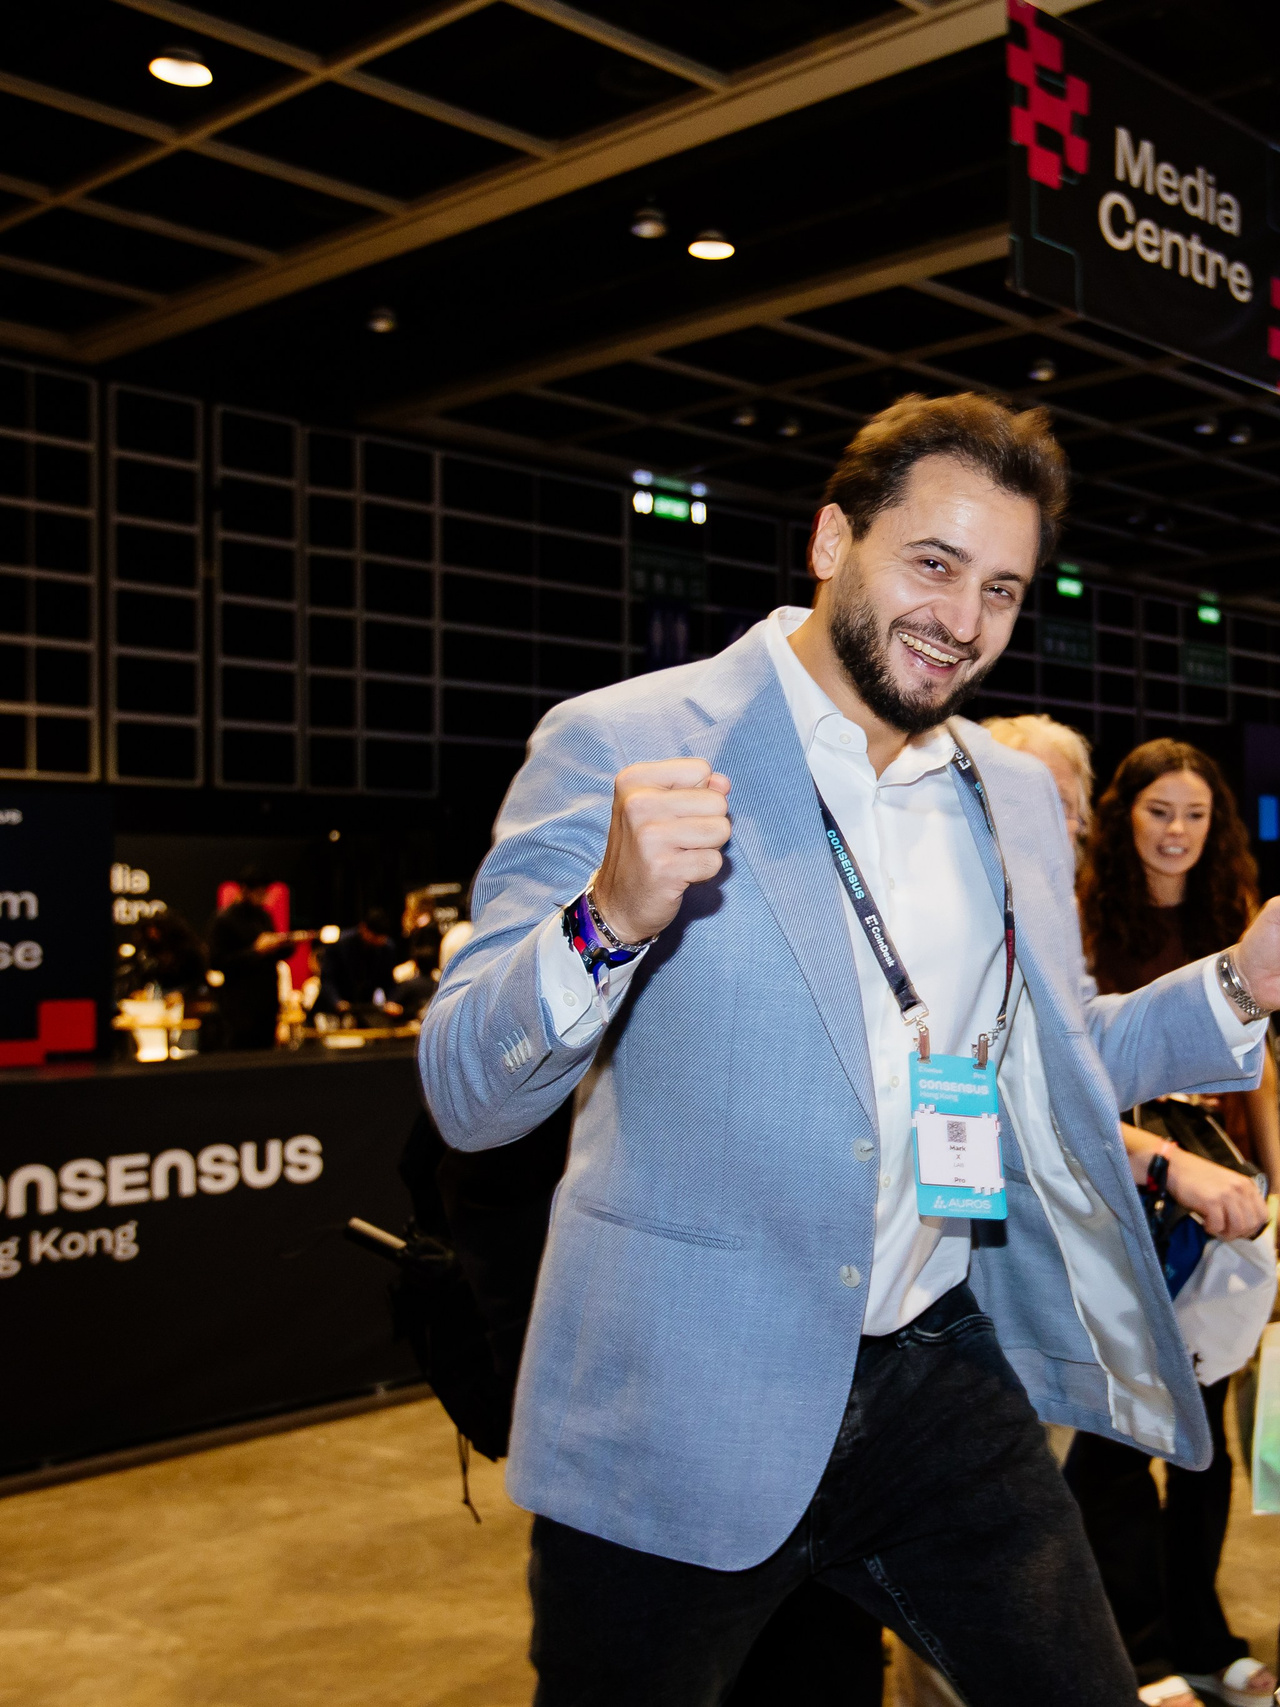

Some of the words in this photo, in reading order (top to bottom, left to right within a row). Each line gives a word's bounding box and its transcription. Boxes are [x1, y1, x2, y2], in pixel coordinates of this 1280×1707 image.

[1115, 126, 1241, 237] Media
[1098, 191, 1252, 303] Centre
[871, 926, 895, 968] CoinDesk
[0, 1134, 324, 1220] NSENSUS
[948, 1197, 992, 1210] AUROS
[29, 1220, 140, 1263] Kong
